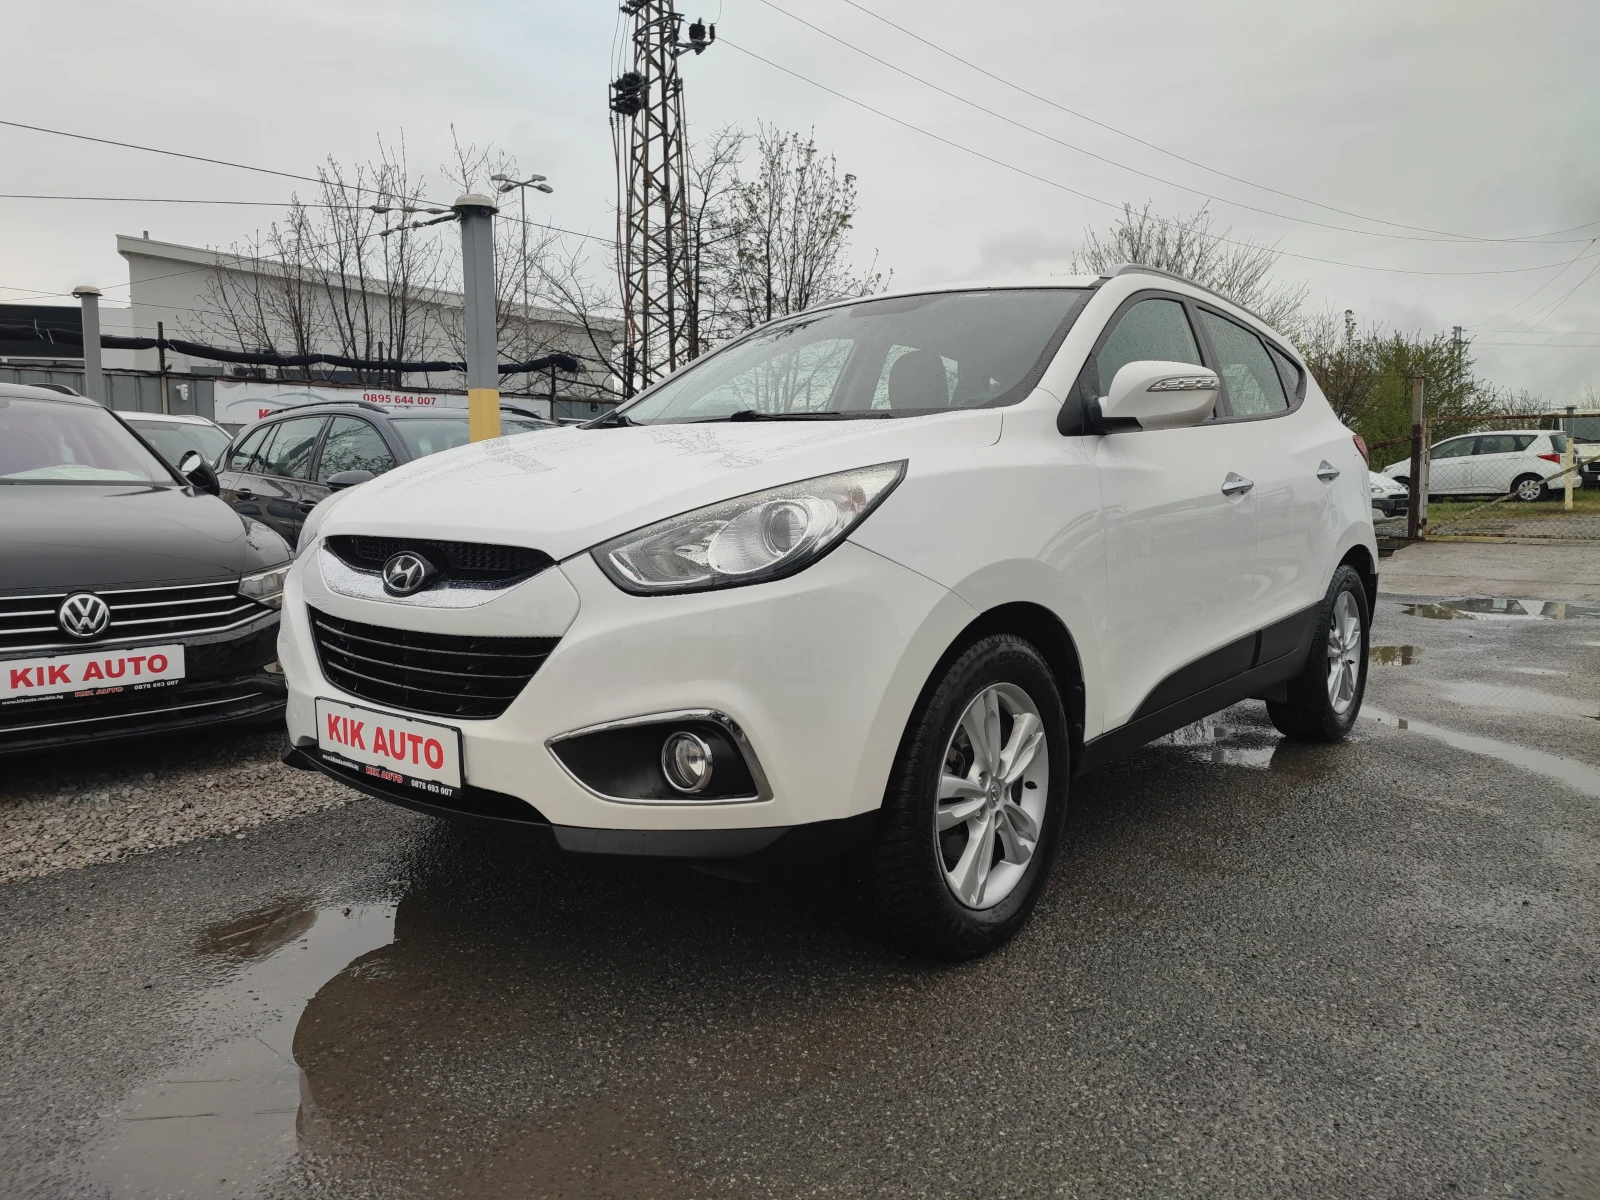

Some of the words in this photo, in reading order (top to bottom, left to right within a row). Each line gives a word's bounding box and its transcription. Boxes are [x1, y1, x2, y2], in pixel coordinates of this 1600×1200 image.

[363, 393, 391, 403] 0895
[395, 395, 414, 404] 644
[417, 396, 437, 405] 007
[9, 664, 72, 689] KIK
[82, 654, 169, 681] AUTO
[74, 690, 95, 698] KIK
[96, 686, 124, 695] AUTO
[327, 713, 366, 751] KIK
[373, 726, 444, 769] AUTO
[365, 766, 380, 777] KIK
[381, 771, 403, 783] AUTO
[411, 779, 426, 790] 0878
[427, 783, 439, 794] 693
[440, 786, 453, 797] 007
